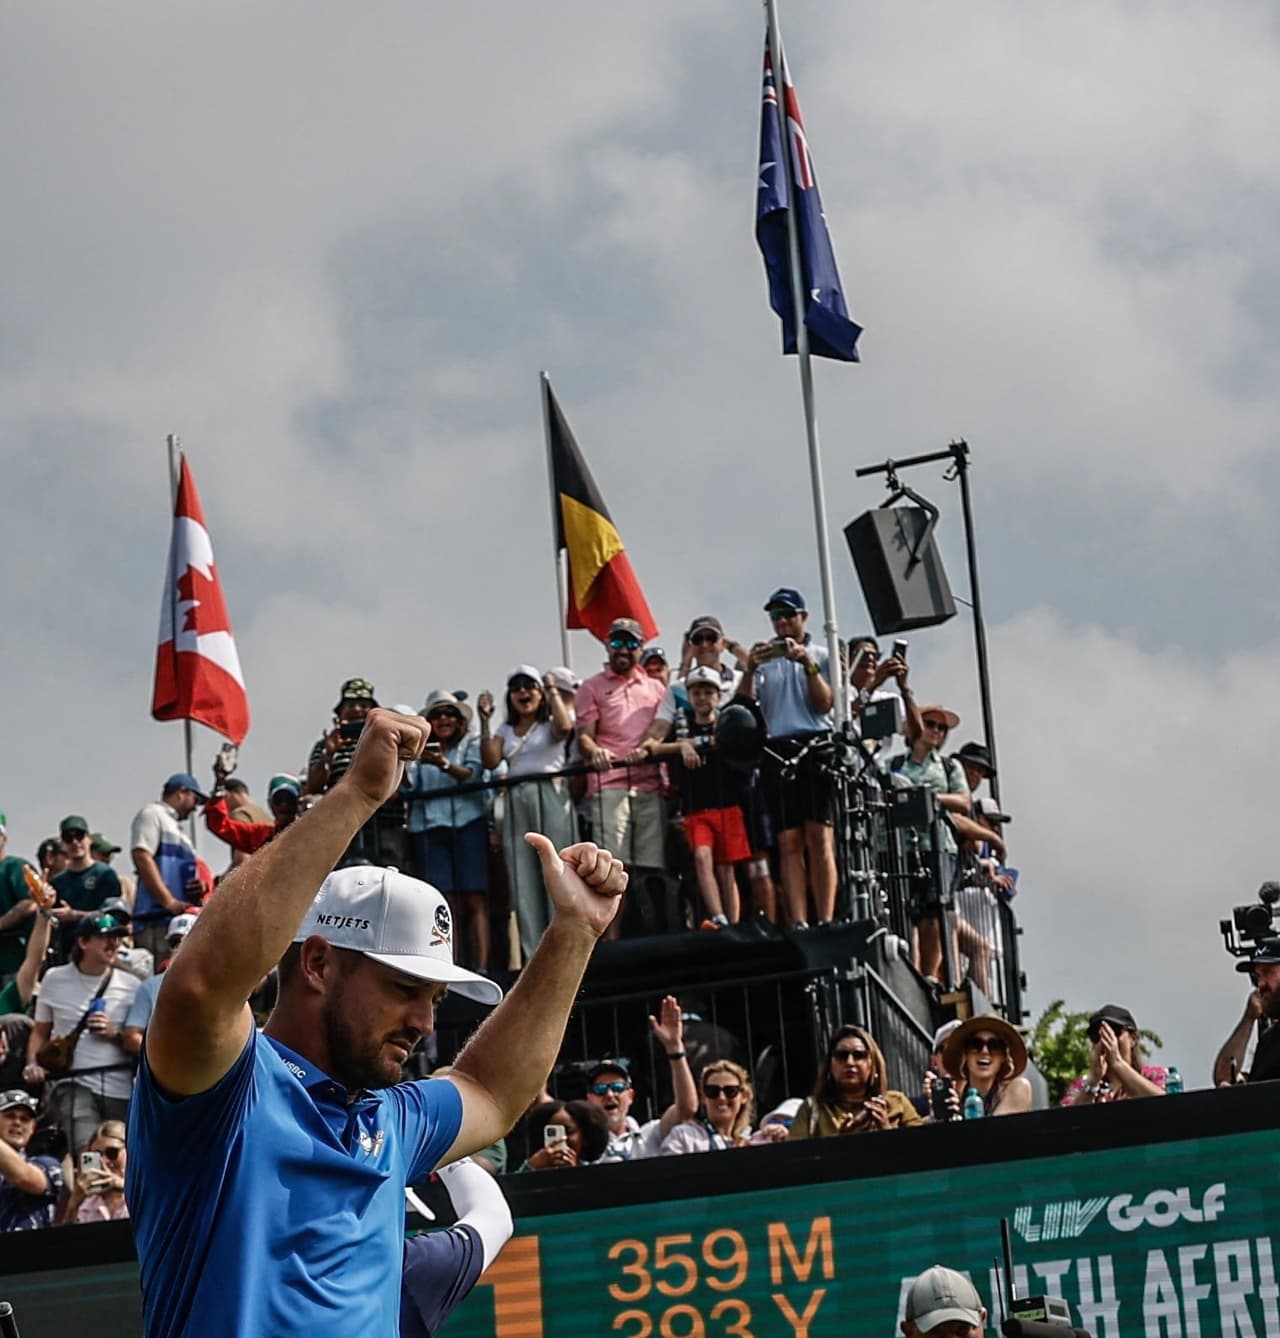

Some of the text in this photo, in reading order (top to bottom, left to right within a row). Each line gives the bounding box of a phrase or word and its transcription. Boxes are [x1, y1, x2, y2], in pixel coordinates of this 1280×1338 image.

[316, 913, 371, 930] NETJETS
[1106, 1182, 1227, 1232] GOLF
[607, 1215, 835, 1302] 359 M
